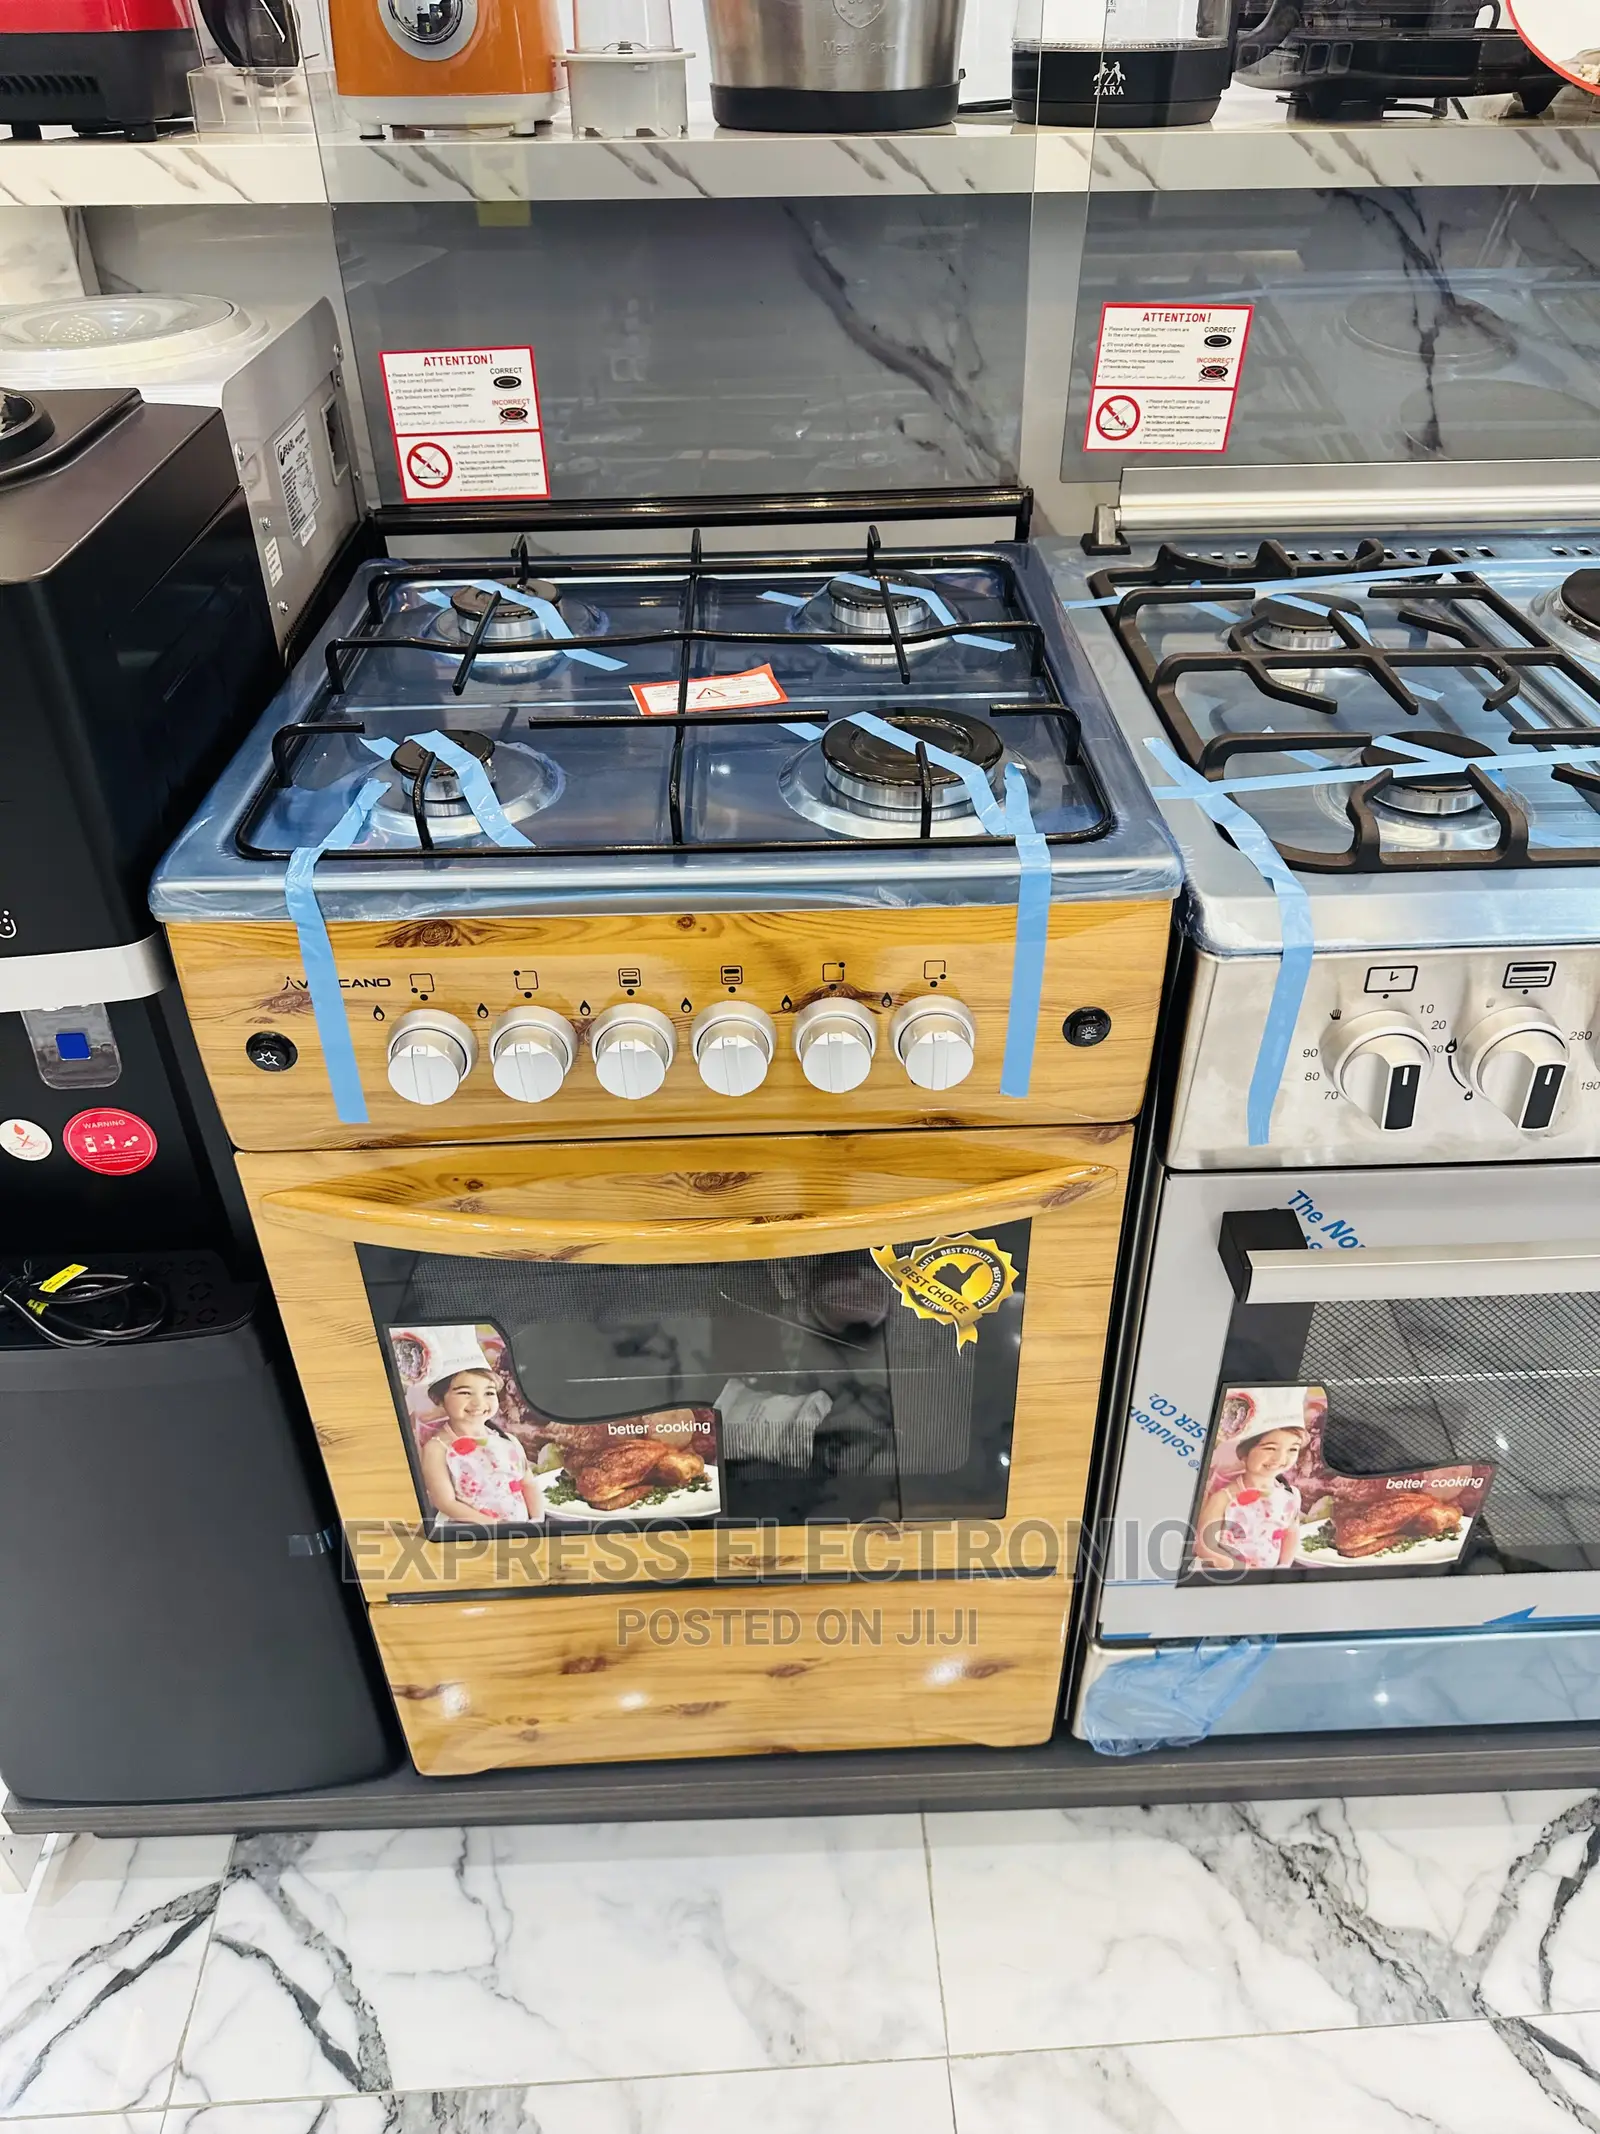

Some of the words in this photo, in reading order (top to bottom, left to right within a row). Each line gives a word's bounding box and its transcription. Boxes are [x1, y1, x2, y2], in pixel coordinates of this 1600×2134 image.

[1093, 86, 1124, 96] ZARA
[1143, 312, 1212, 323] ATTENTION!
[424, 354, 494, 367] ATTENTION!
[296, 978, 392, 989] VCANO
[1419, 1004, 1435, 1014] 10
[1431, 1020, 1446, 1030] 20
[1569, 1030, 1593, 1041] 280
[1302, 1048, 1318, 1058] 90
[1304, 1072, 1320, 1081] 80
[1581, 1081, 1600, 1091] 190
[1324, 1091, 1339, 1100] 70
[82, 1119, 126, 1129] WARNING
[1288, 1190, 1324, 1224] The
[940, 1248, 962, 1256] BEST
[962, 1248, 995, 1264] QUALITY
[992, 1266, 1001, 1282] BEST
[900, 1266, 930, 1288] BEST
[927, 1285, 970, 1314] CHOICE
[977, 1282, 1000, 1306] QUALITY
[608, 1422, 649, 1436] better
[655, 1420, 711, 1435] cooking
[1386, 1478, 1427, 1490] better
[1430, 1476, 1484, 1490] cooking
